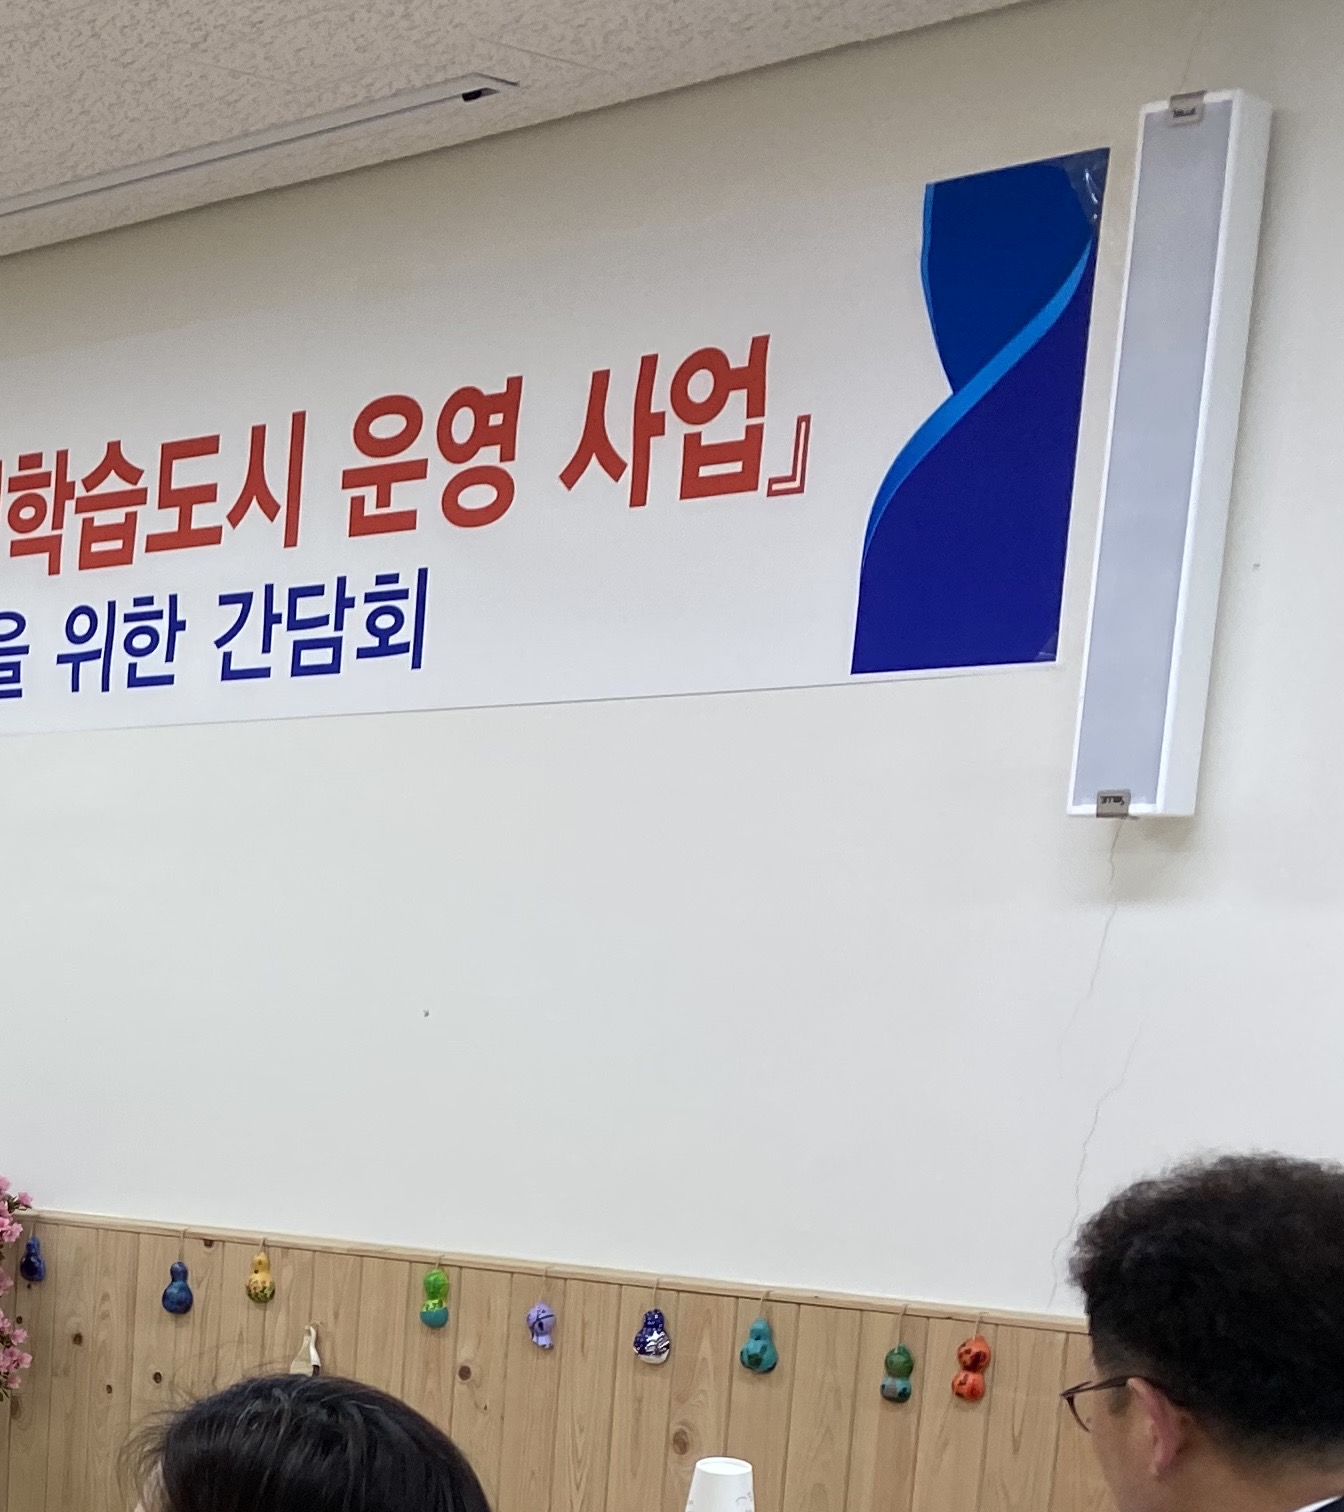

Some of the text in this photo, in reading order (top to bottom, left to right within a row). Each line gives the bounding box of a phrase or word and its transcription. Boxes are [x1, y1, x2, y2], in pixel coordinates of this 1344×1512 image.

[341, 376, 524, 529] 운영
[56, 593, 187, 693] 위한
[213, 567, 429, 682] 간담회
